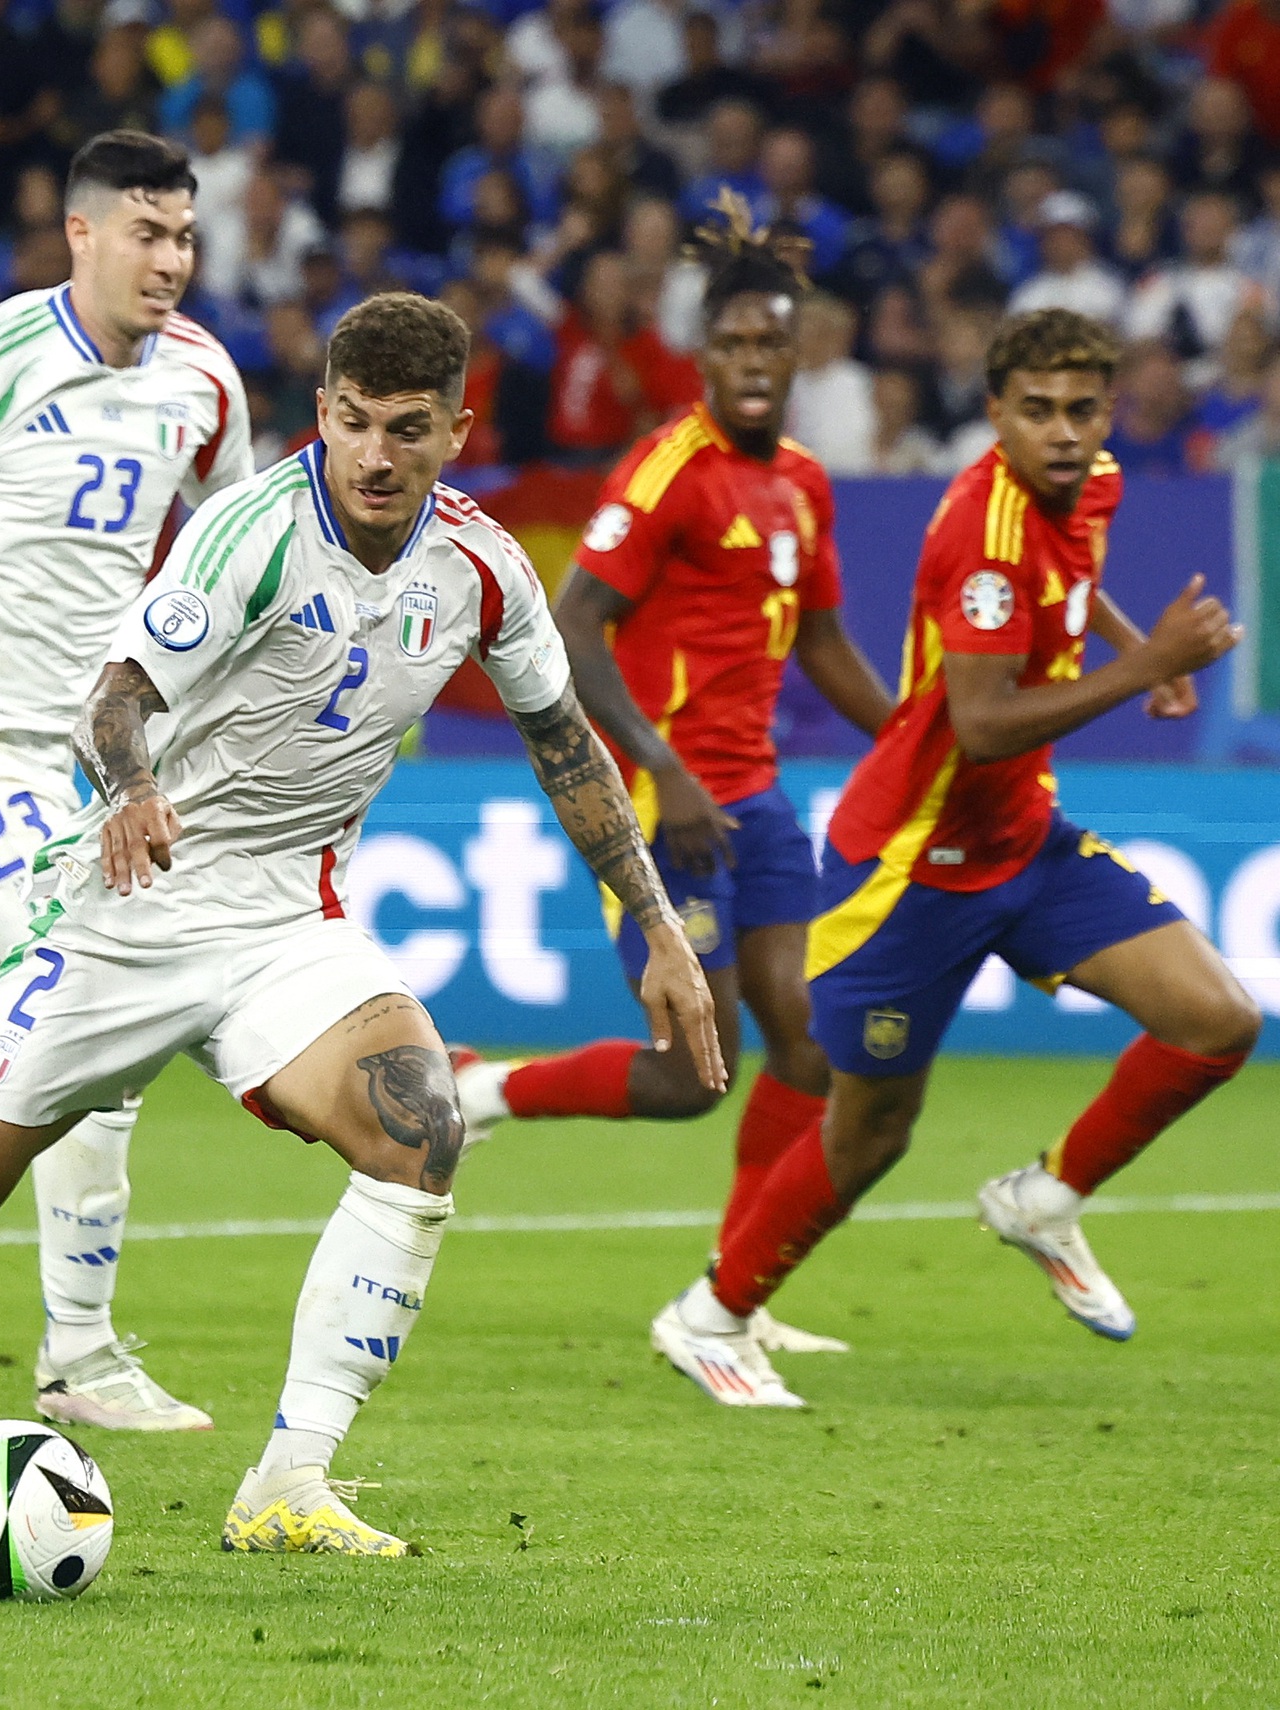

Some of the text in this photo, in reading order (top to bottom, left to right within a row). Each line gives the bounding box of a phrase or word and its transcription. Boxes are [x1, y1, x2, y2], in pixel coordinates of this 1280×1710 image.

[65, 454, 142, 534] 23
[404, 596, 435, 611] ITALIA
[314, 646, 369, 733] 2
[8, 947, 64, 1031] 2
